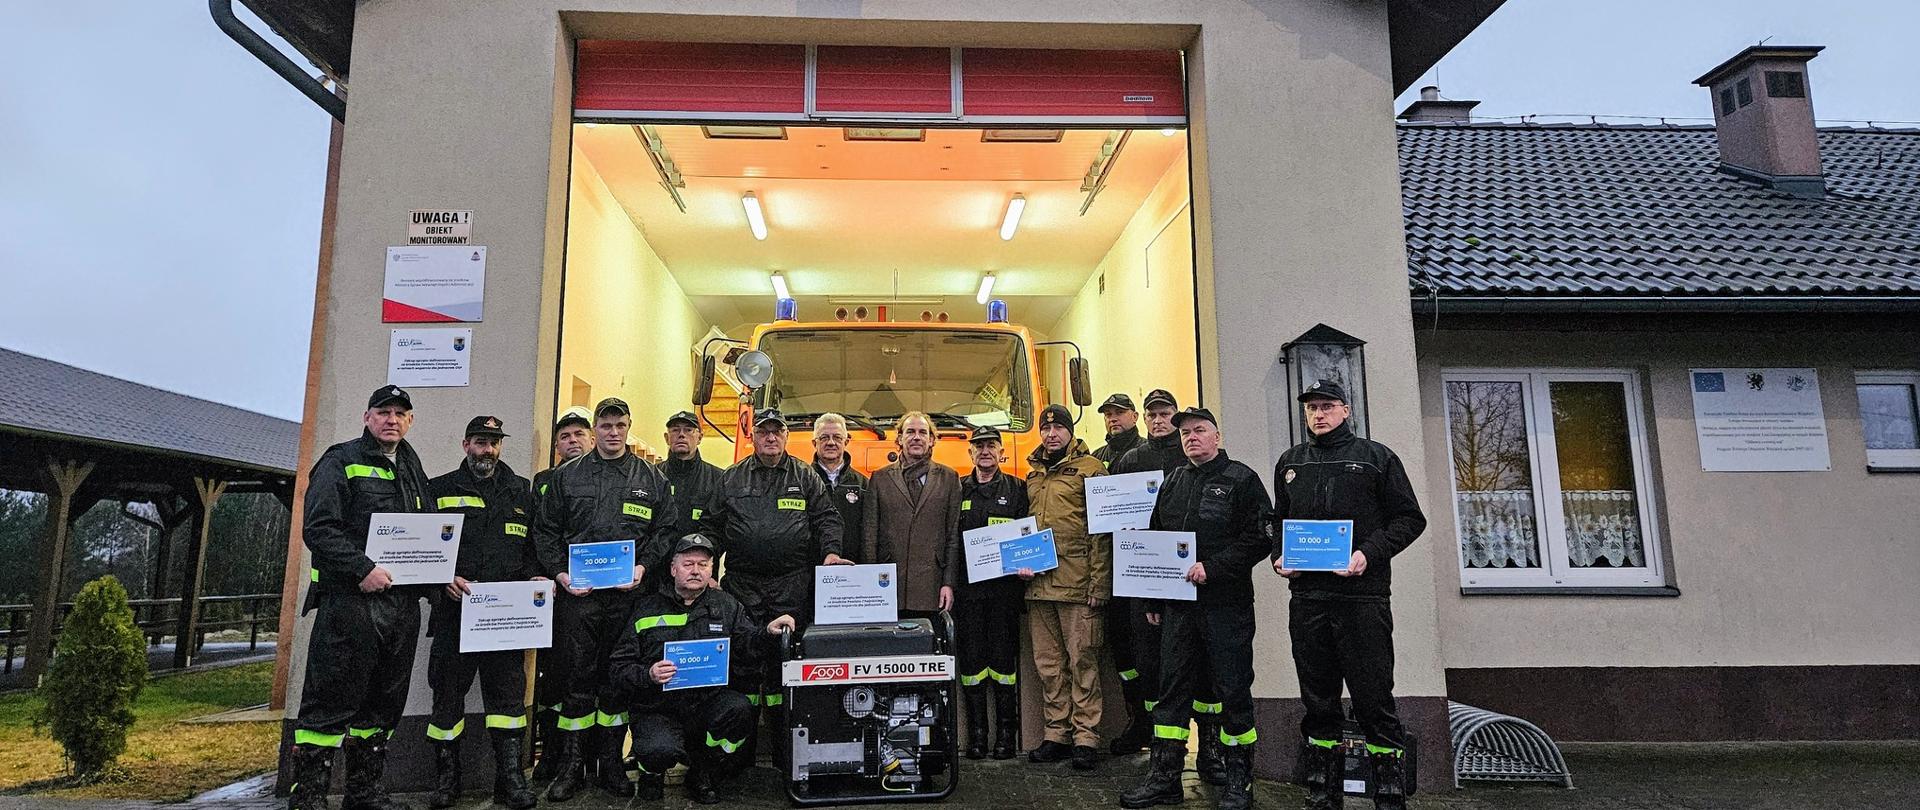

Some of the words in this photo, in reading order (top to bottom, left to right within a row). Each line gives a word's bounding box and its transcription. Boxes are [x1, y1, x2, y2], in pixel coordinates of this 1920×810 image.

[412, 212, 458, 224] UWAGA
[464, 212, 468, 224] !
[426, 226, 454, 234] OBIEKT
[410, 236, 468, 244] MONITOROWANY
[854, 664, 872, 675] FV
[876, 663, 915, 674] 15000
[920, 662, 946, 672] TRE
